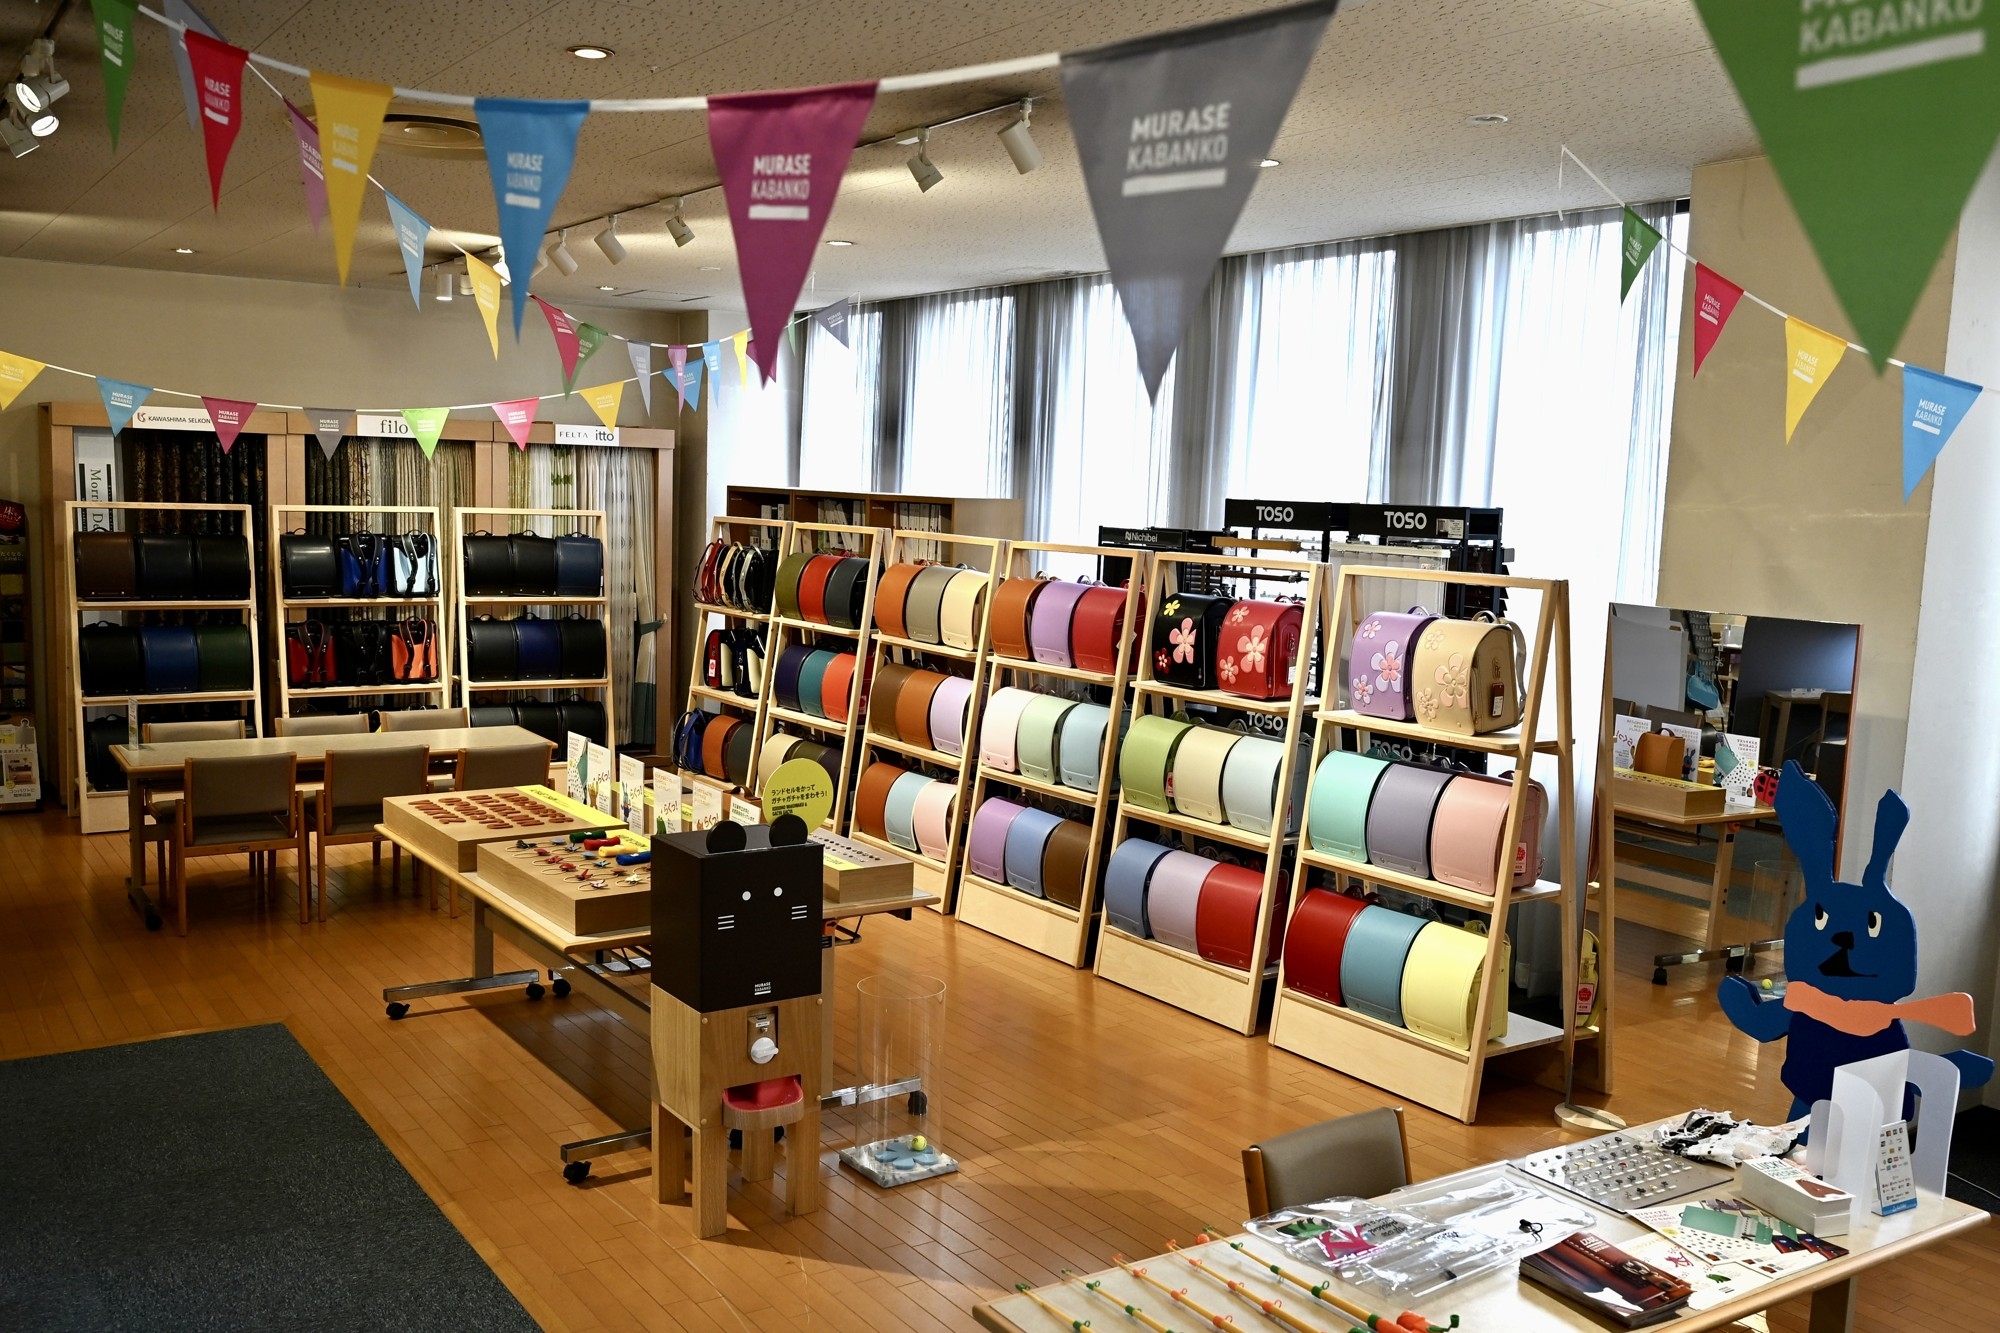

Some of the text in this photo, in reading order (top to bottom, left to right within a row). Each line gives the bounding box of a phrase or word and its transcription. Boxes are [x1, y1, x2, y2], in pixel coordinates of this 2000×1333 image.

[1131, 102, 1230, 142] MURASE
[1127, 134, 1228, 172] KABANKO
[506, 152, 544, 172] MURASE
[753, 153, 811, 175] MURASE
[751, 178, 810, 200] KABANKO
[1797, 350, 1819, 366] MURASE
[112, 391, 133, 401] MURASE
[218, 409, 239, 417] MURASE
[1918, 399, 1947, 416] MURASE
[148, 415, 187, 423] KAWASHIMA
[188, 417, 211, 425] SELKON
[1915, 409, 1943, 426] KABANKO
[380, 419, 409, 435] filo
[559, 431, 589, 439] FELTA
[595, 429, 615, 442] itto
[1255, 505, 1295, 523] TOSO
[1383, 510, 1428, 530] TOSO
[1131, 532, 1158, 543] Nichibei
[1246, 711, 1284, 732] TOSO
